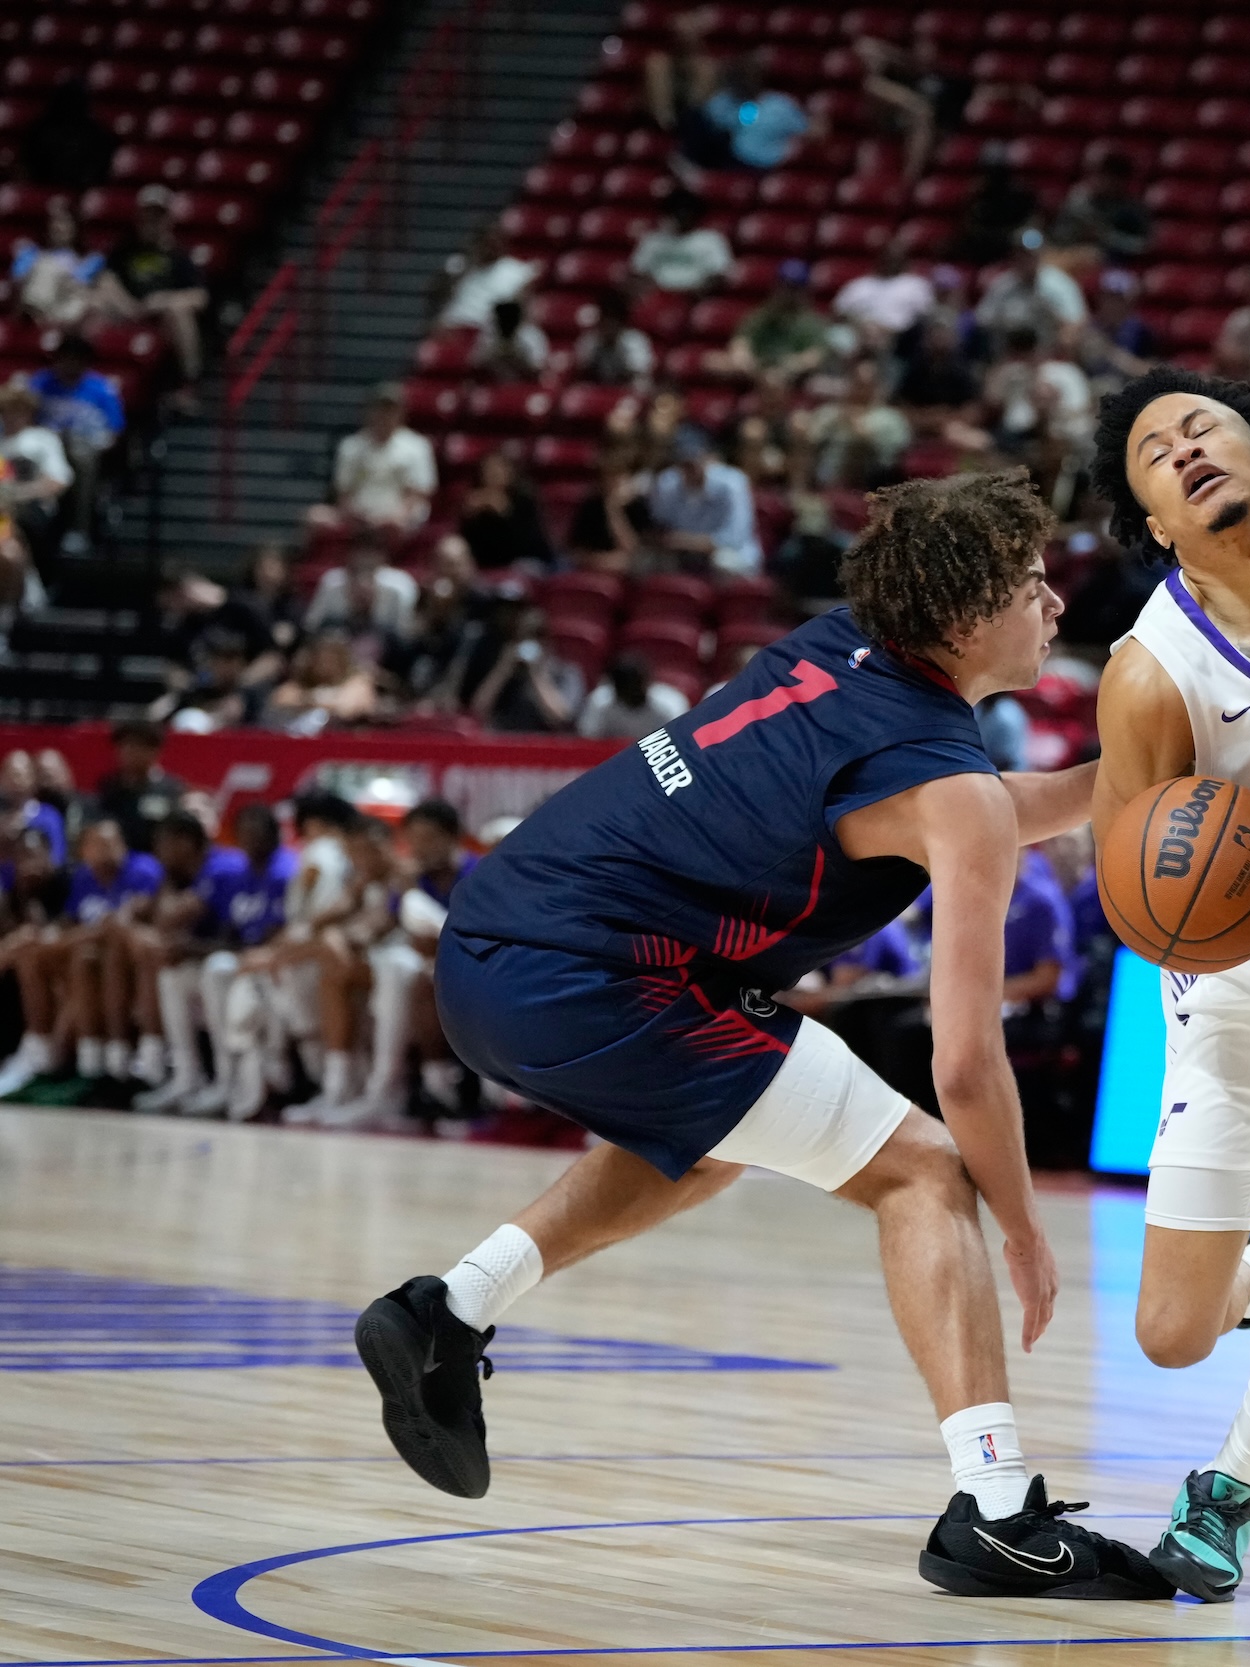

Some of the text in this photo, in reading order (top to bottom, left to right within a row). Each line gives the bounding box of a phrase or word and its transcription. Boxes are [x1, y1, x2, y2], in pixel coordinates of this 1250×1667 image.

[692, 658, 839, 750] 1
[637, 727, 693, 797] WAGLER
[1153, 779, 1226, 880] Wilson
